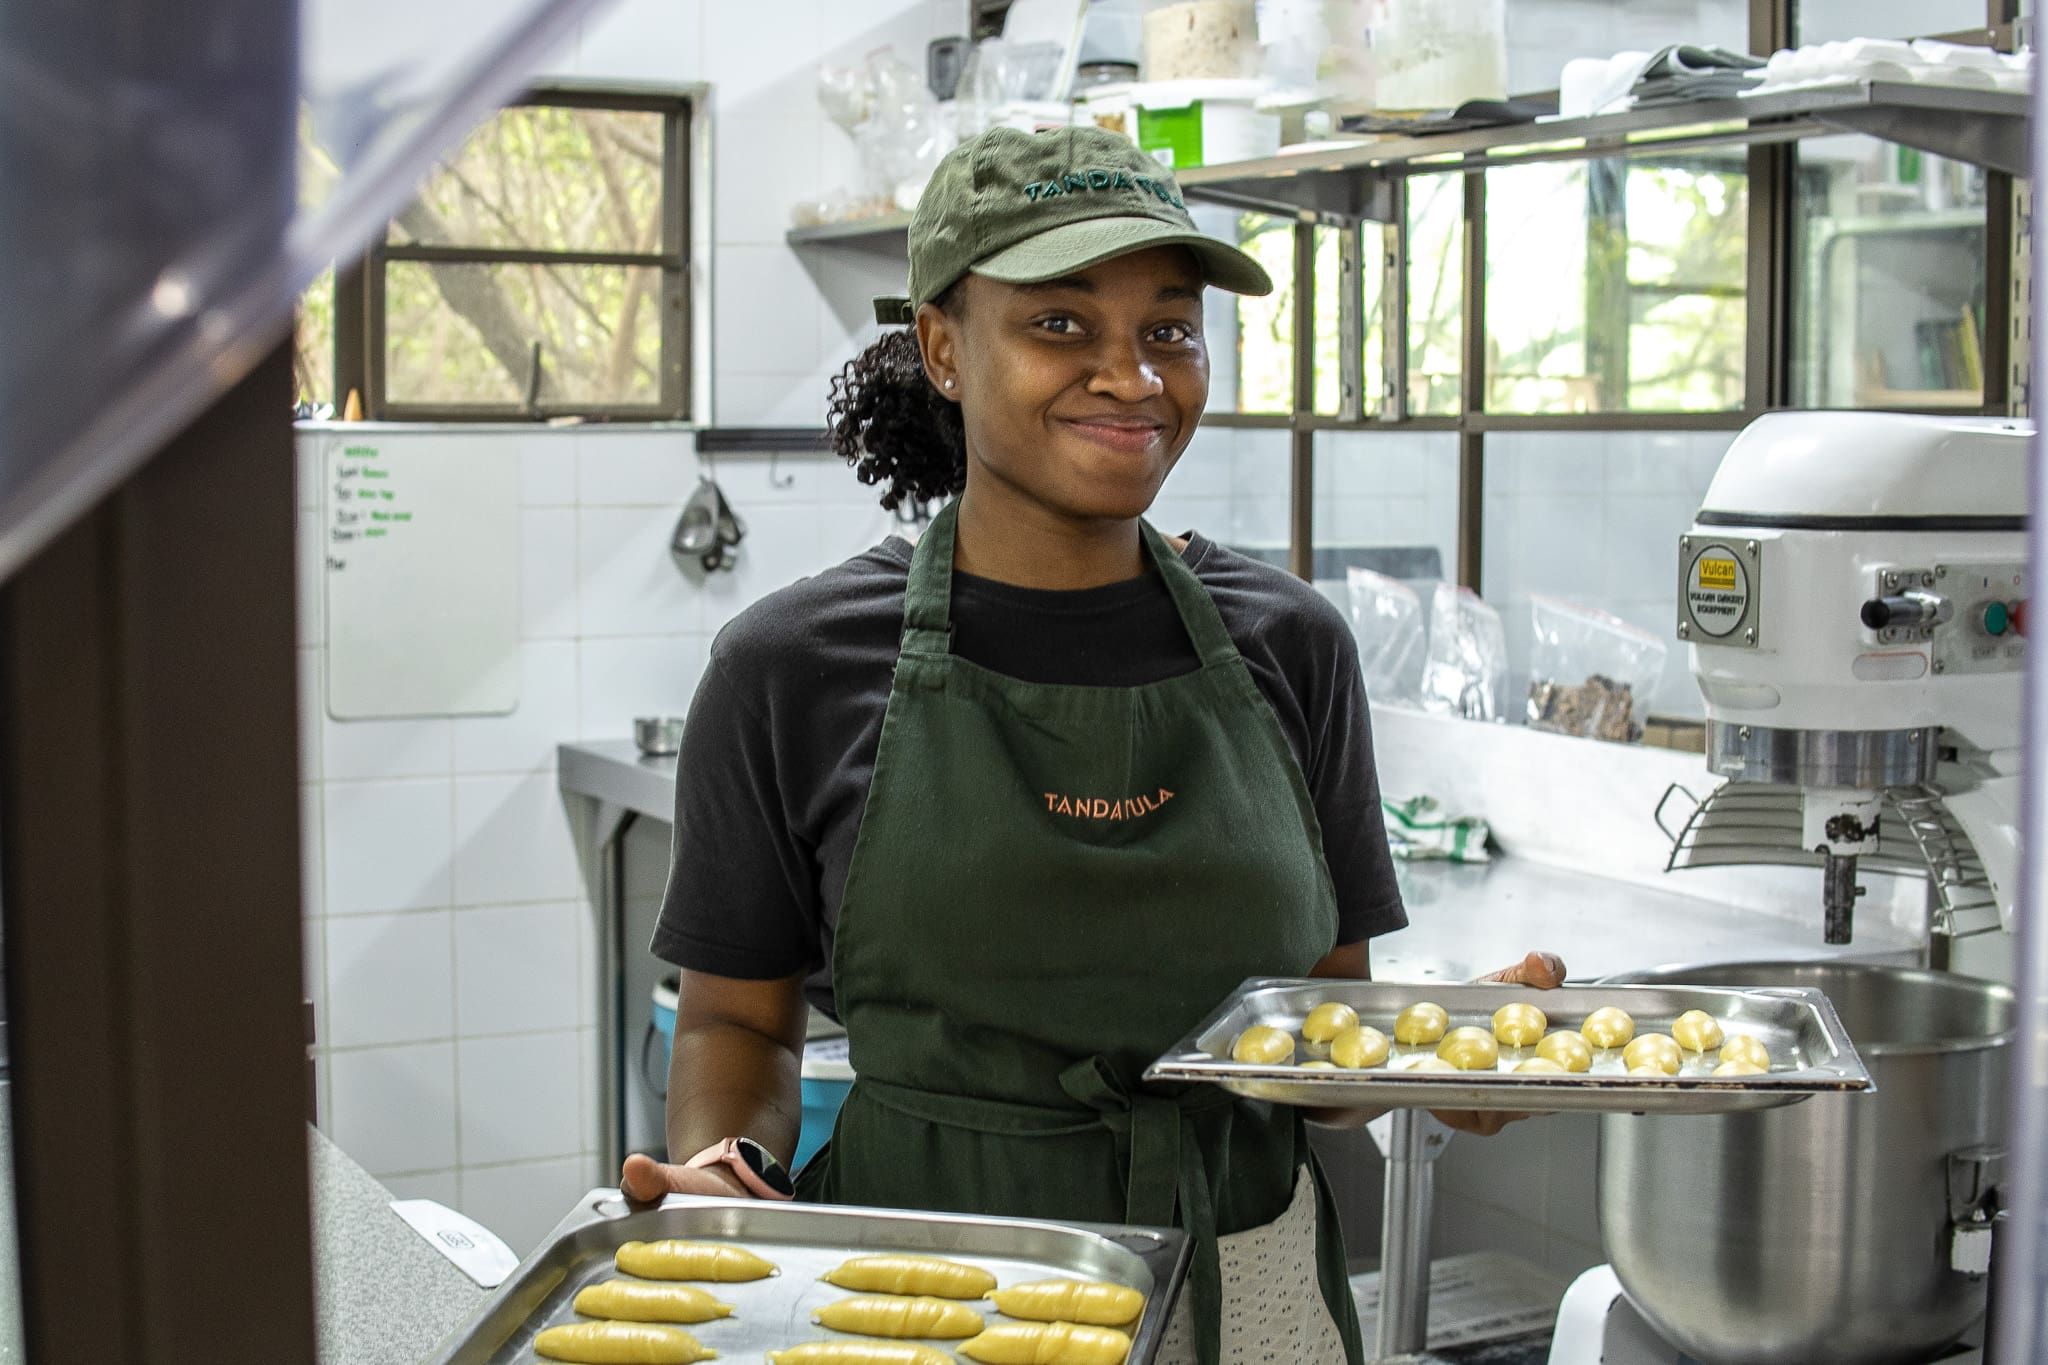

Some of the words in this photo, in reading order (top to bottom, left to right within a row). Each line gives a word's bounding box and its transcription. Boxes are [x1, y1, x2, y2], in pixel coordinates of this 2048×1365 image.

[1702, 560, 1734, 577] Vulcan
[1690, 592, 1716, 603] VULCAN
[1697, 604, 1736, 616] EQUIPMENT
[1044, 788, 1175, 821] TANDATULA
